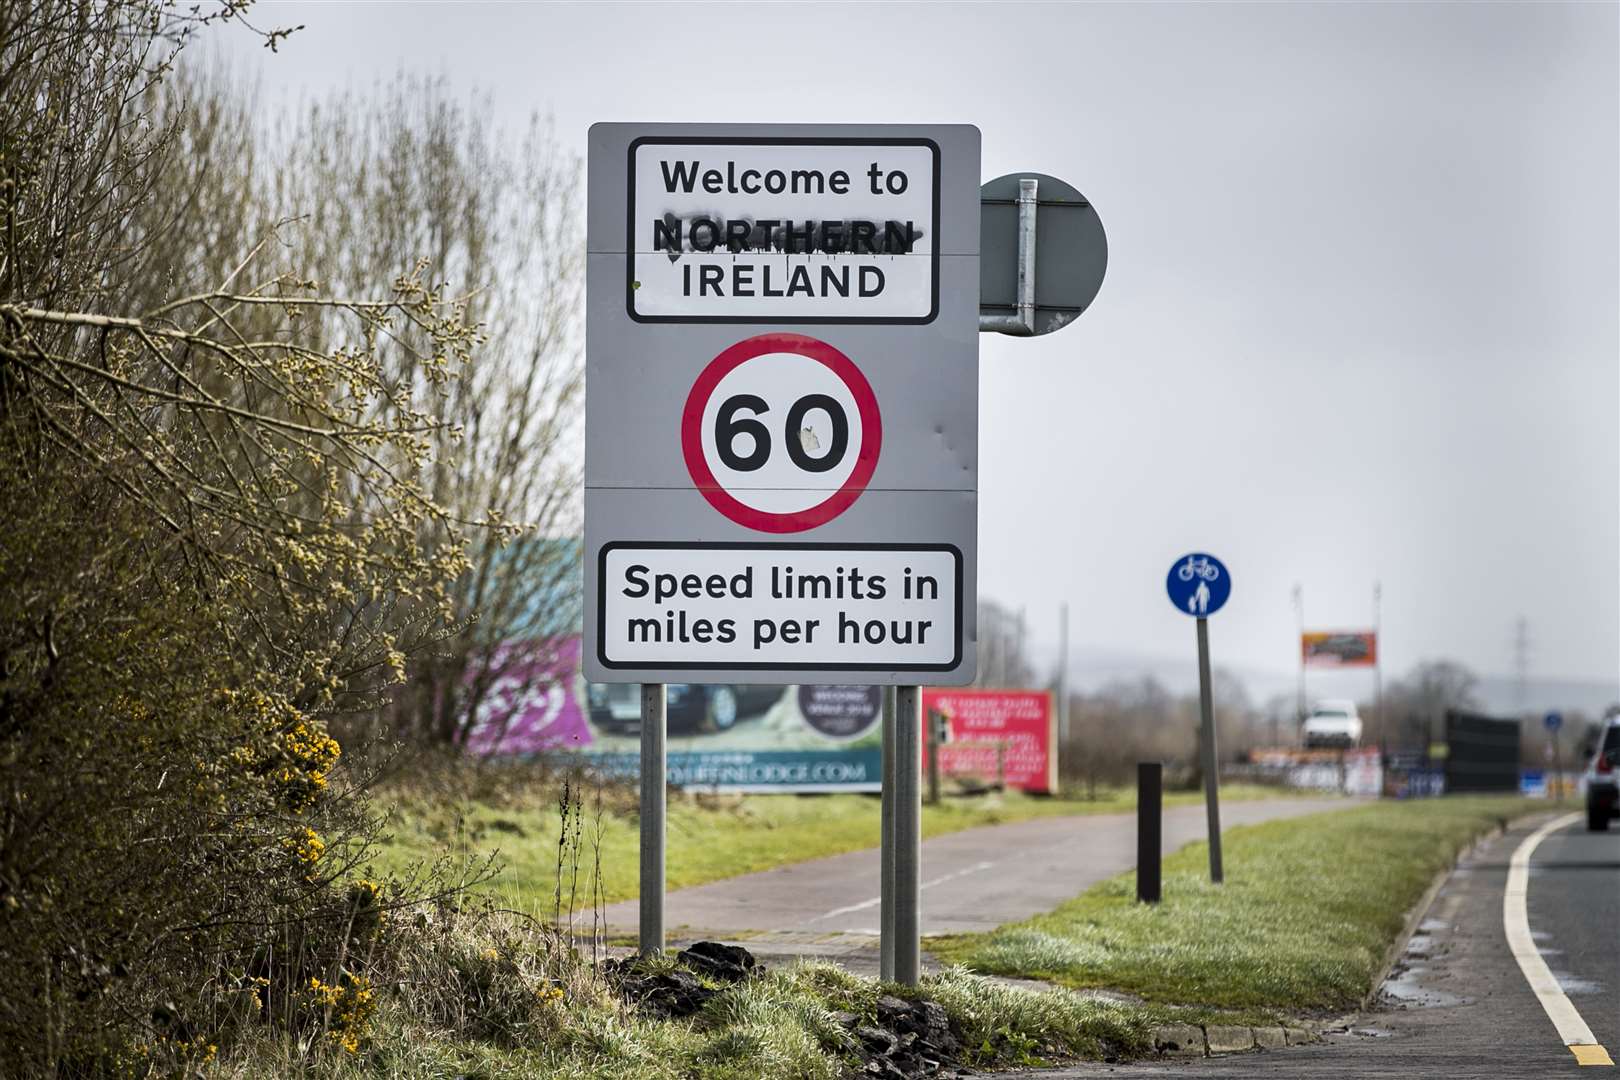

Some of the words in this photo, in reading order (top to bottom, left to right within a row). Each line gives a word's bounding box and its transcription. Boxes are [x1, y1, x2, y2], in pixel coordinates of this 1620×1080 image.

[660, 160, 851, 195] Welcome
[867, 162, 909, 195] to
[653, 218, 915, 254] NORTHERN
[683, 264, 886, 298] IRELAND
[714, 393, 850, 473] 60
[622, 564, 753, 604] Speed
[771, 566, 887, 600] limits
[904, 567, 938, 600] in
[628, 611, 736, 644] miles
[753, 619, 820, 650] per
[838, 611, 932, 645] hour
